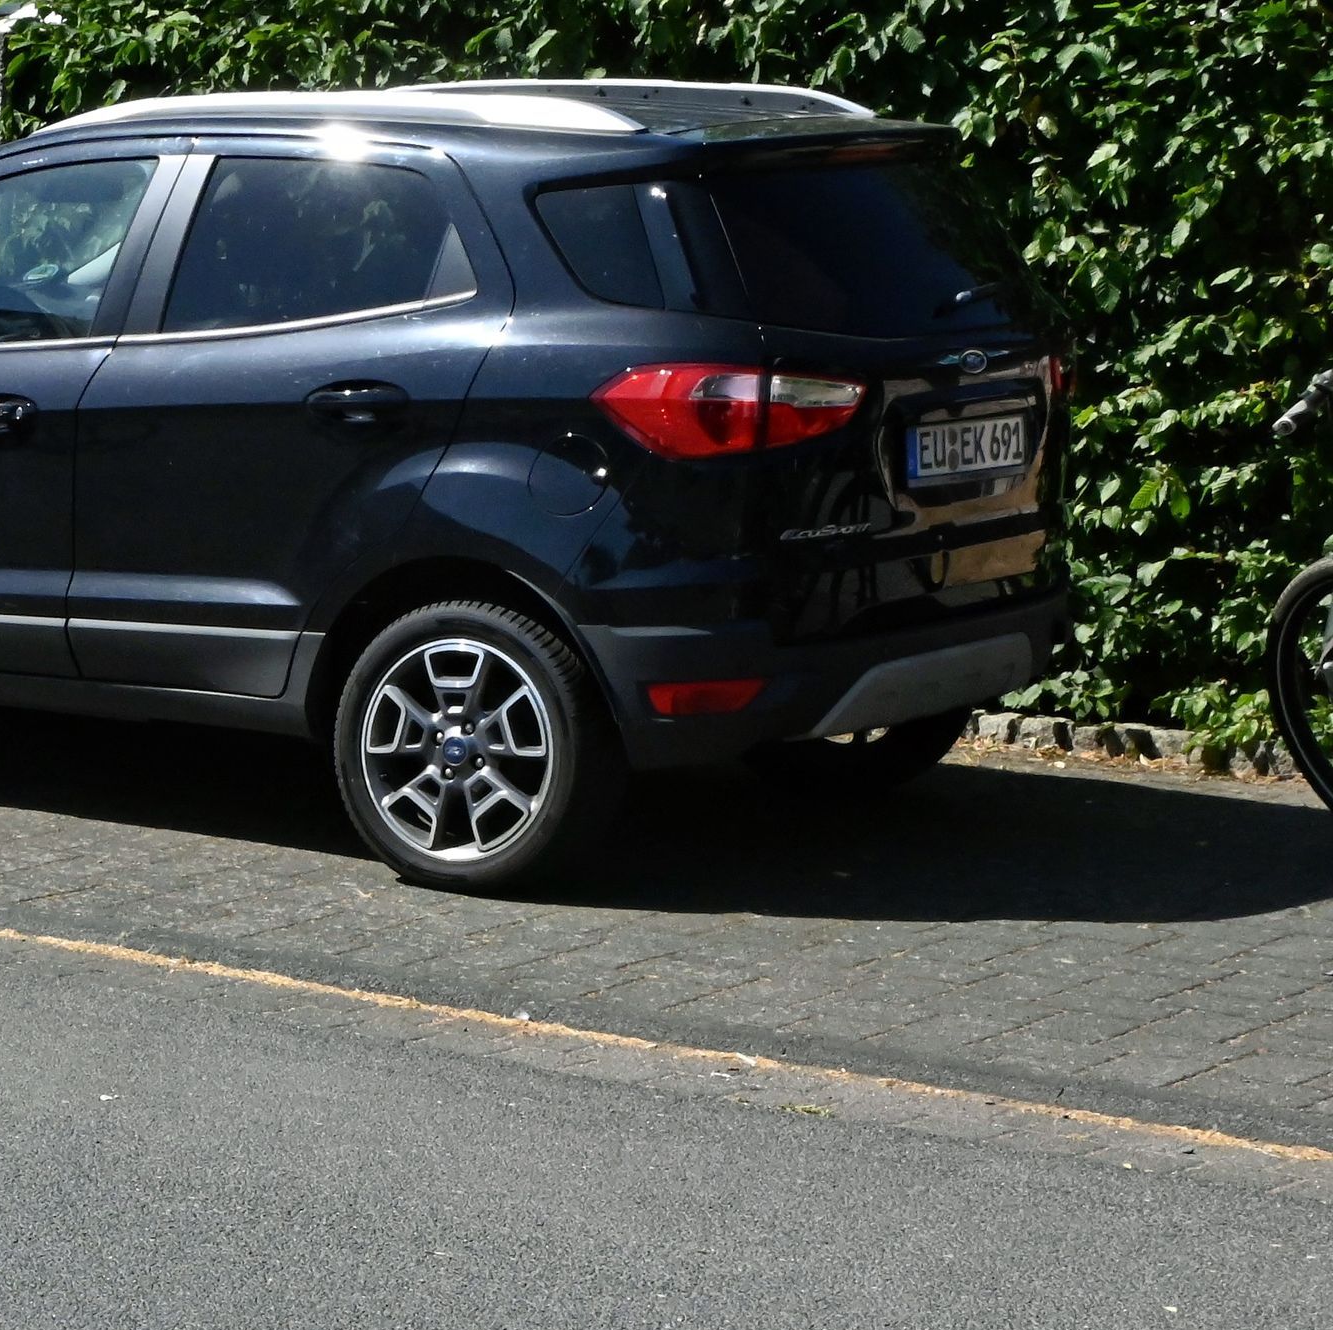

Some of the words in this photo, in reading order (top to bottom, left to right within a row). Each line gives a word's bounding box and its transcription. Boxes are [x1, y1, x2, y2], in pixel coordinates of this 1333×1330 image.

[919, 430, 946, 470] EU
[960, 425, 986, 465] EK
[990, 421, 1023, 461] 691
